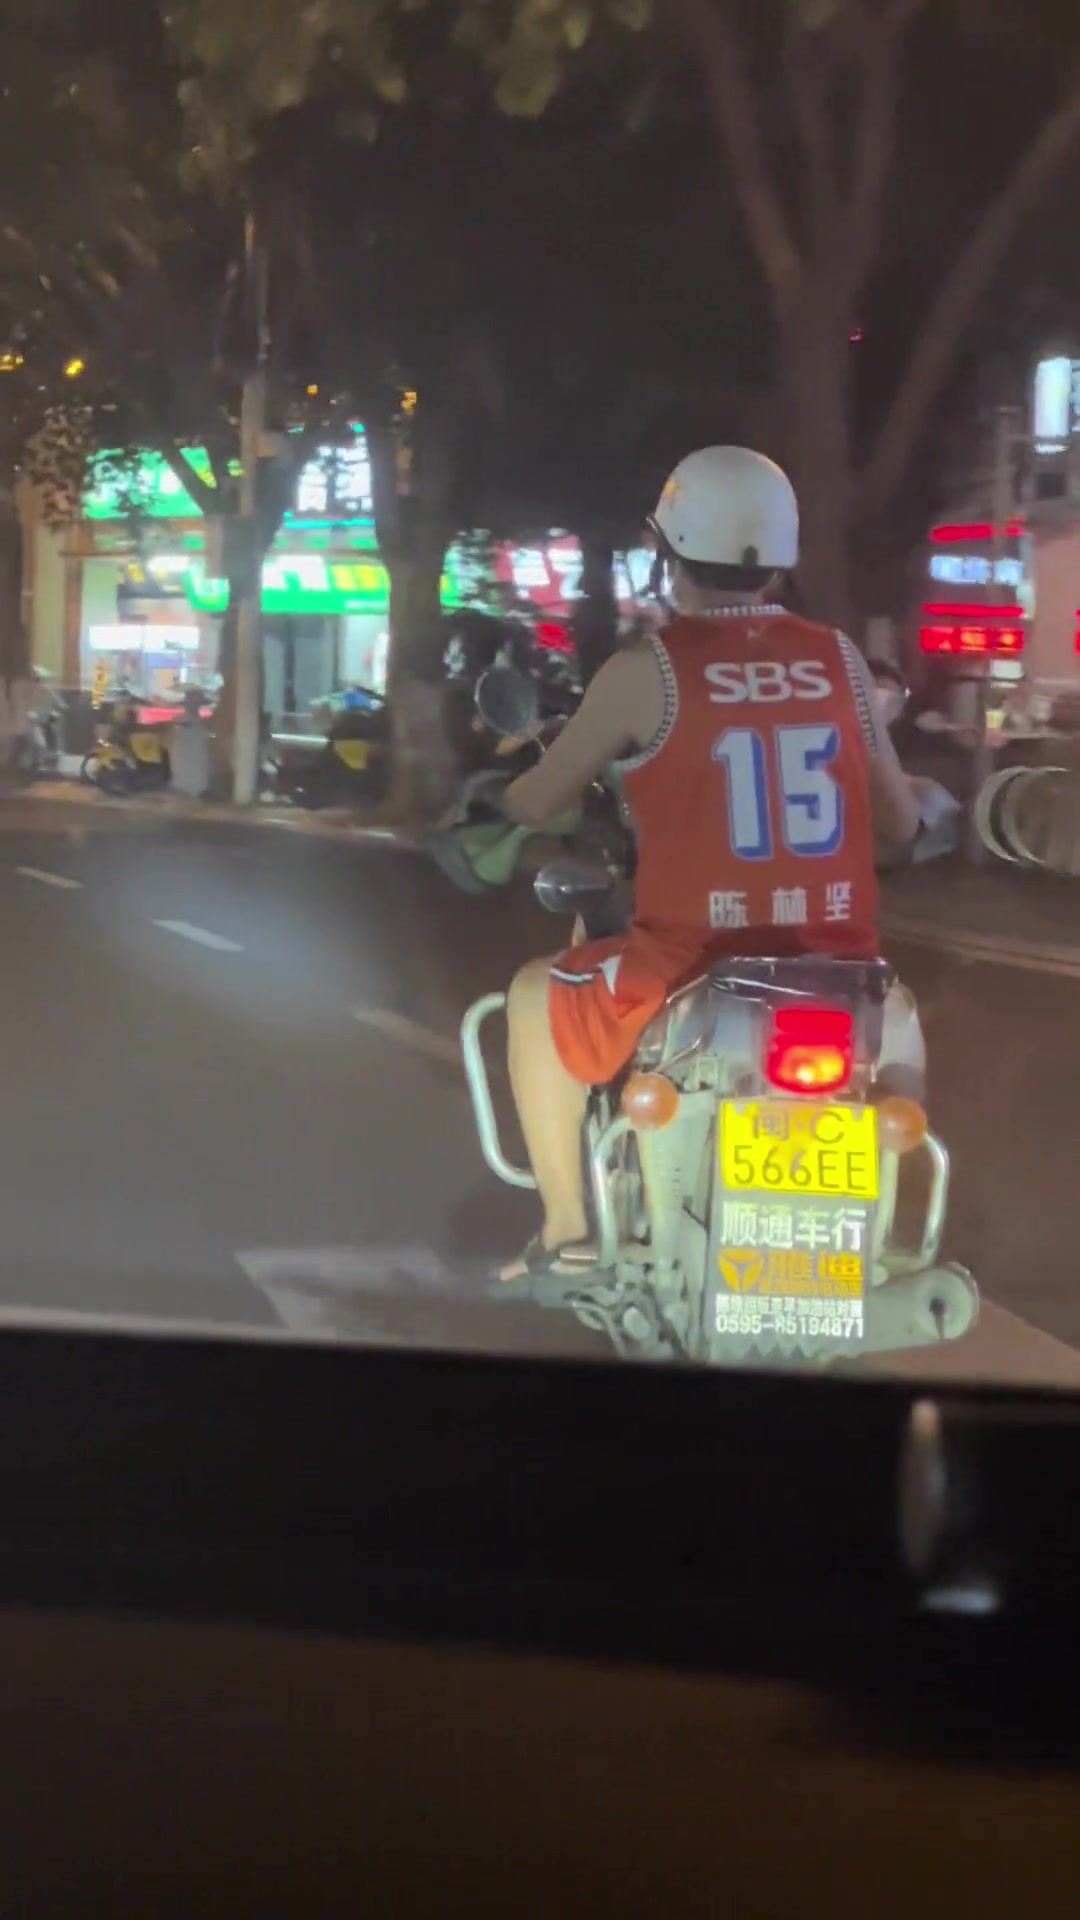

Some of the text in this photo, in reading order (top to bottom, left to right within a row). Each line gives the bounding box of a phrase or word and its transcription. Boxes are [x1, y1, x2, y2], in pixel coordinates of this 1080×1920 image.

[704, 660, 833, 703] SBS
[712, 723, 845, 861] 15
[733, 1145, 867, 1190] 566EE
[721, 1201, 866, 1251] 顺通车行
